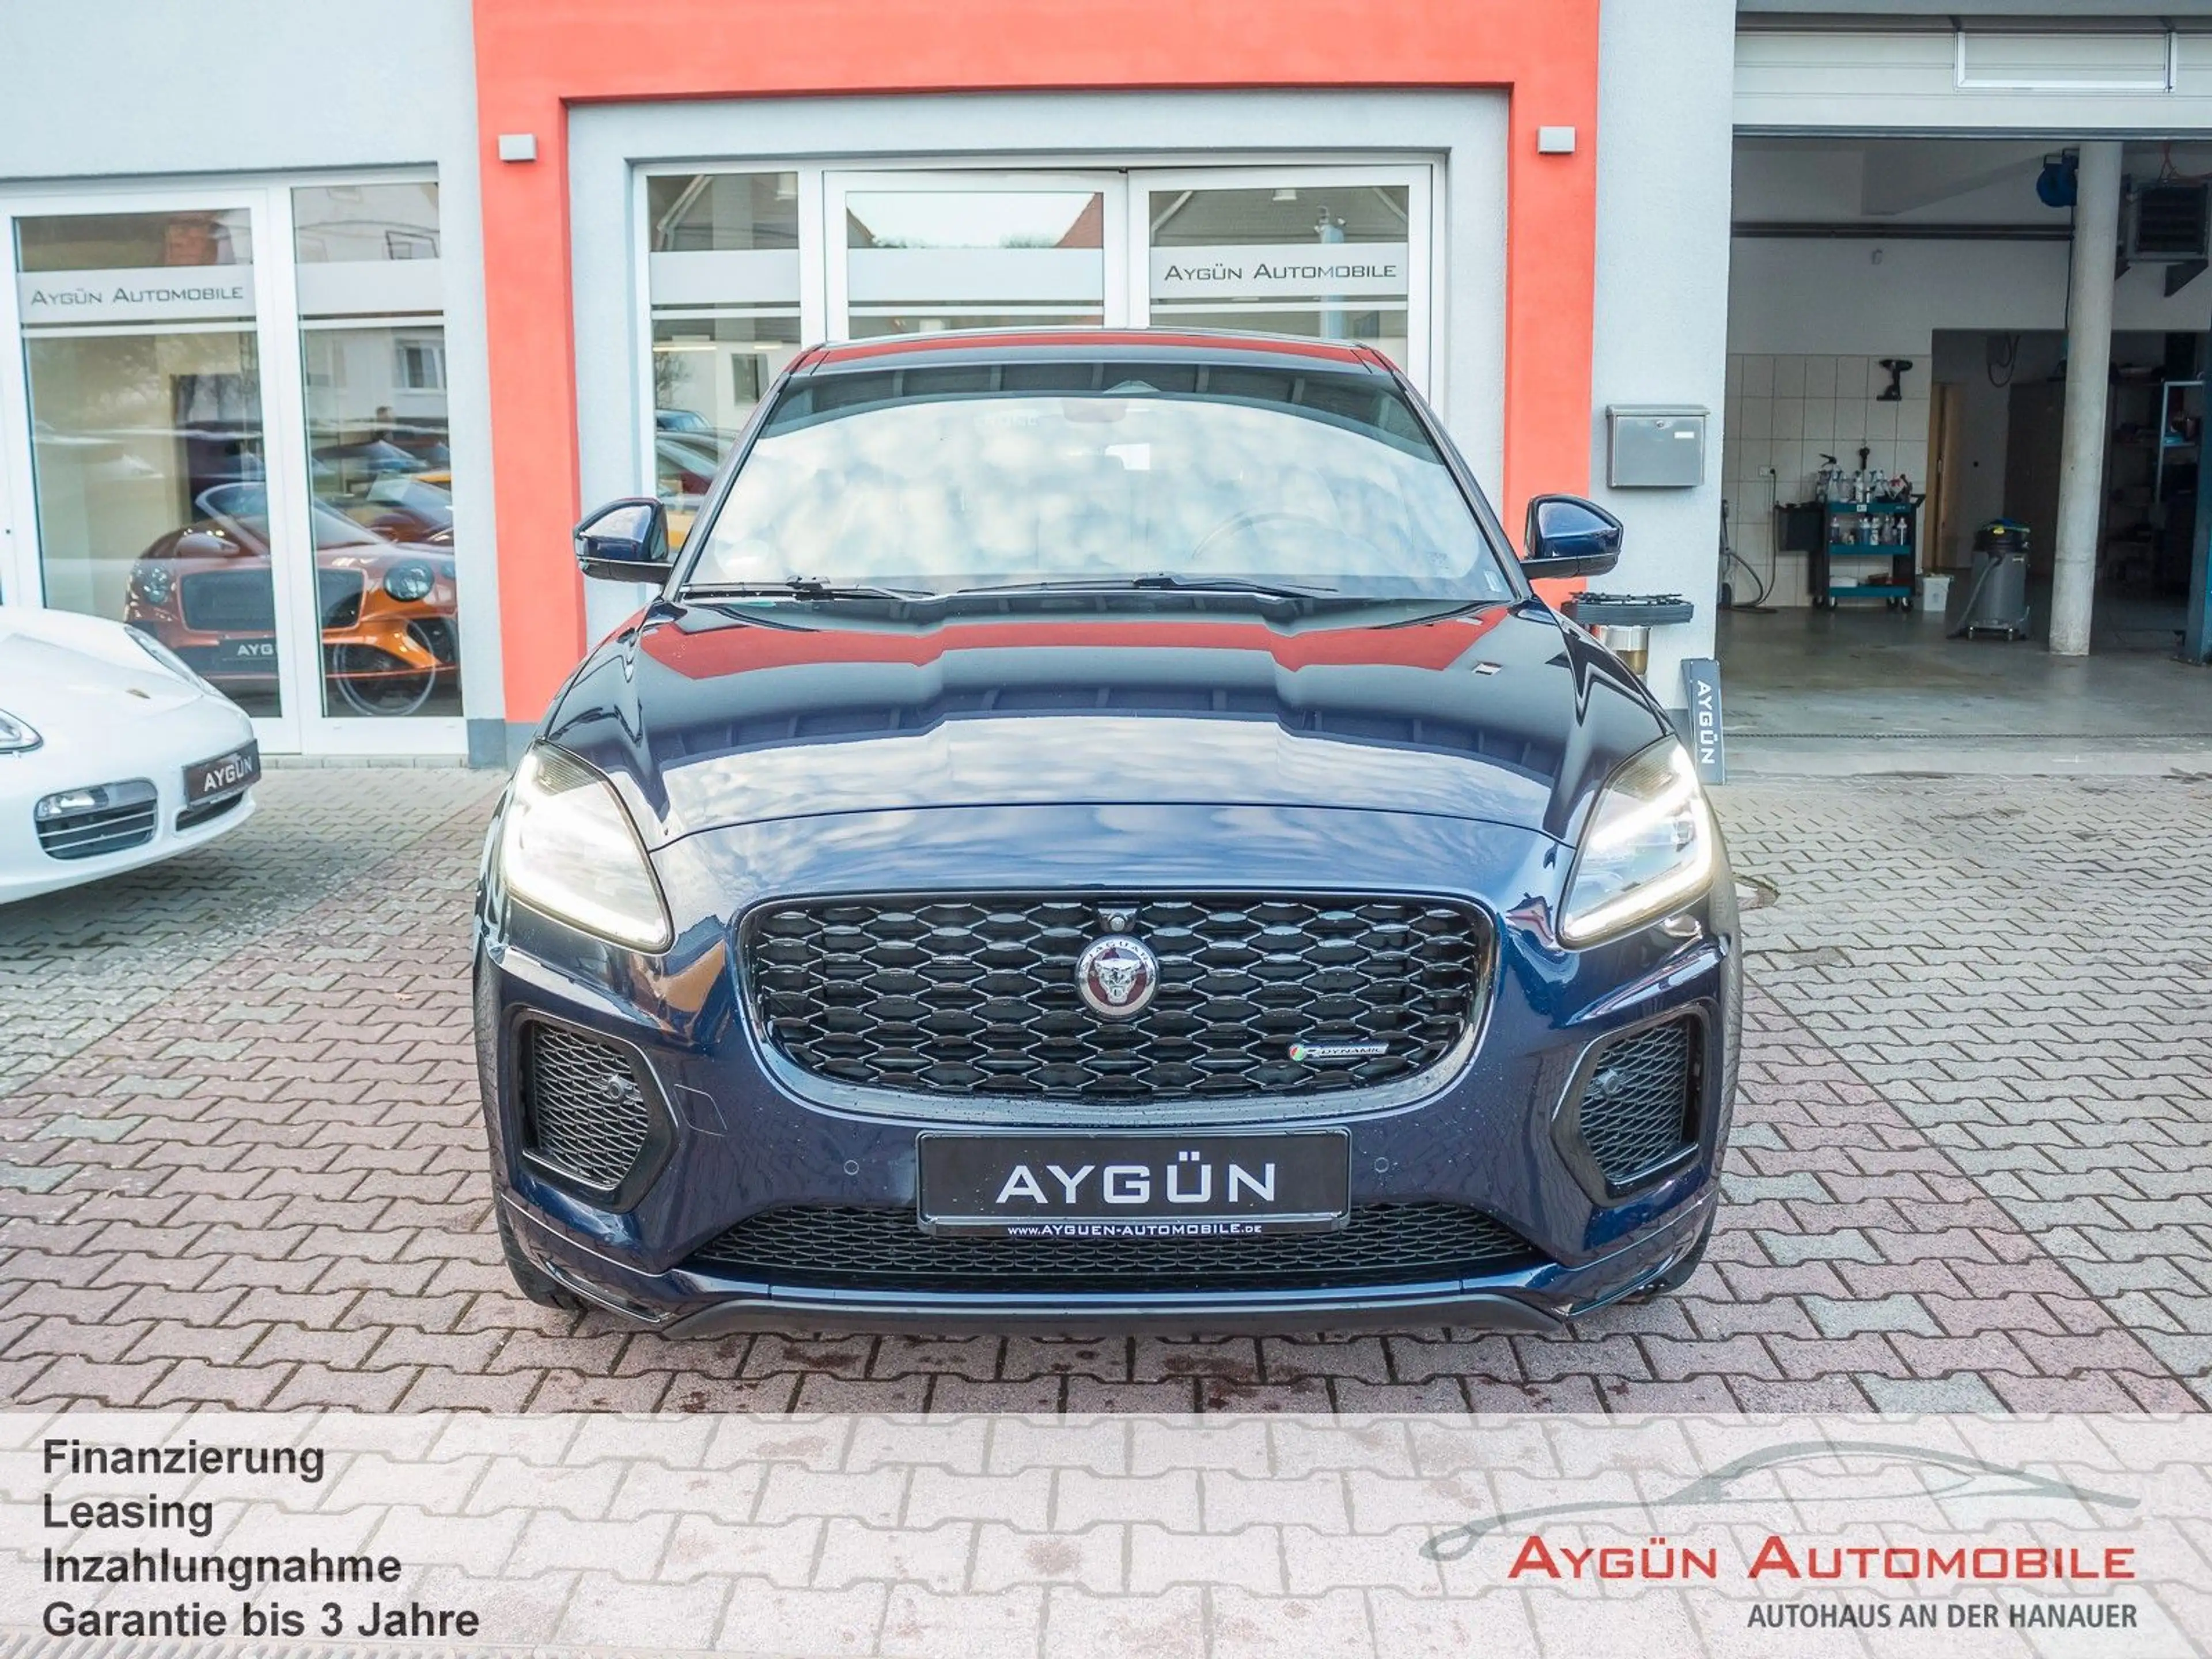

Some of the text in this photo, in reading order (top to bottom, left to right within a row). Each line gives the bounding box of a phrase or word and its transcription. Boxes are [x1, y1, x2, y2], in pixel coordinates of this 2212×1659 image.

[1165, 263, 1397, 281] AYGÜN AUTOMOBILE
[113, 287, 243, 303] AUTOMOBILE
[1697, 680, 1718, 764] AYGÜN
[204, 753, 252, 792] AYGÜN
[995, 1151, 1275, 1204] AYGÜN
